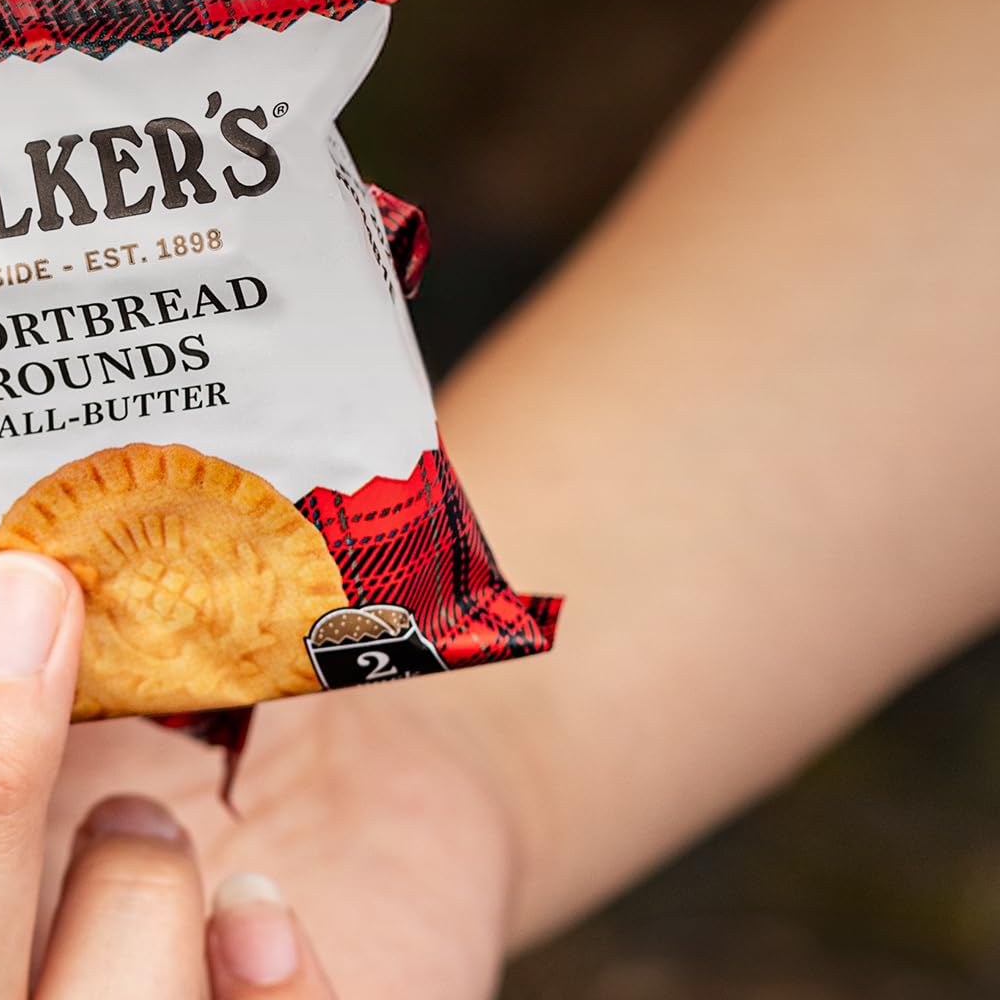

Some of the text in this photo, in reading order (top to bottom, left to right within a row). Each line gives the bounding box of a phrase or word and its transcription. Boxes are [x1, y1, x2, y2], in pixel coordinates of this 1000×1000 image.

[85, 242, 148, 273] EST.
[155, 227, 224, 260] 1898
[356, 650, 399, 681] 2
